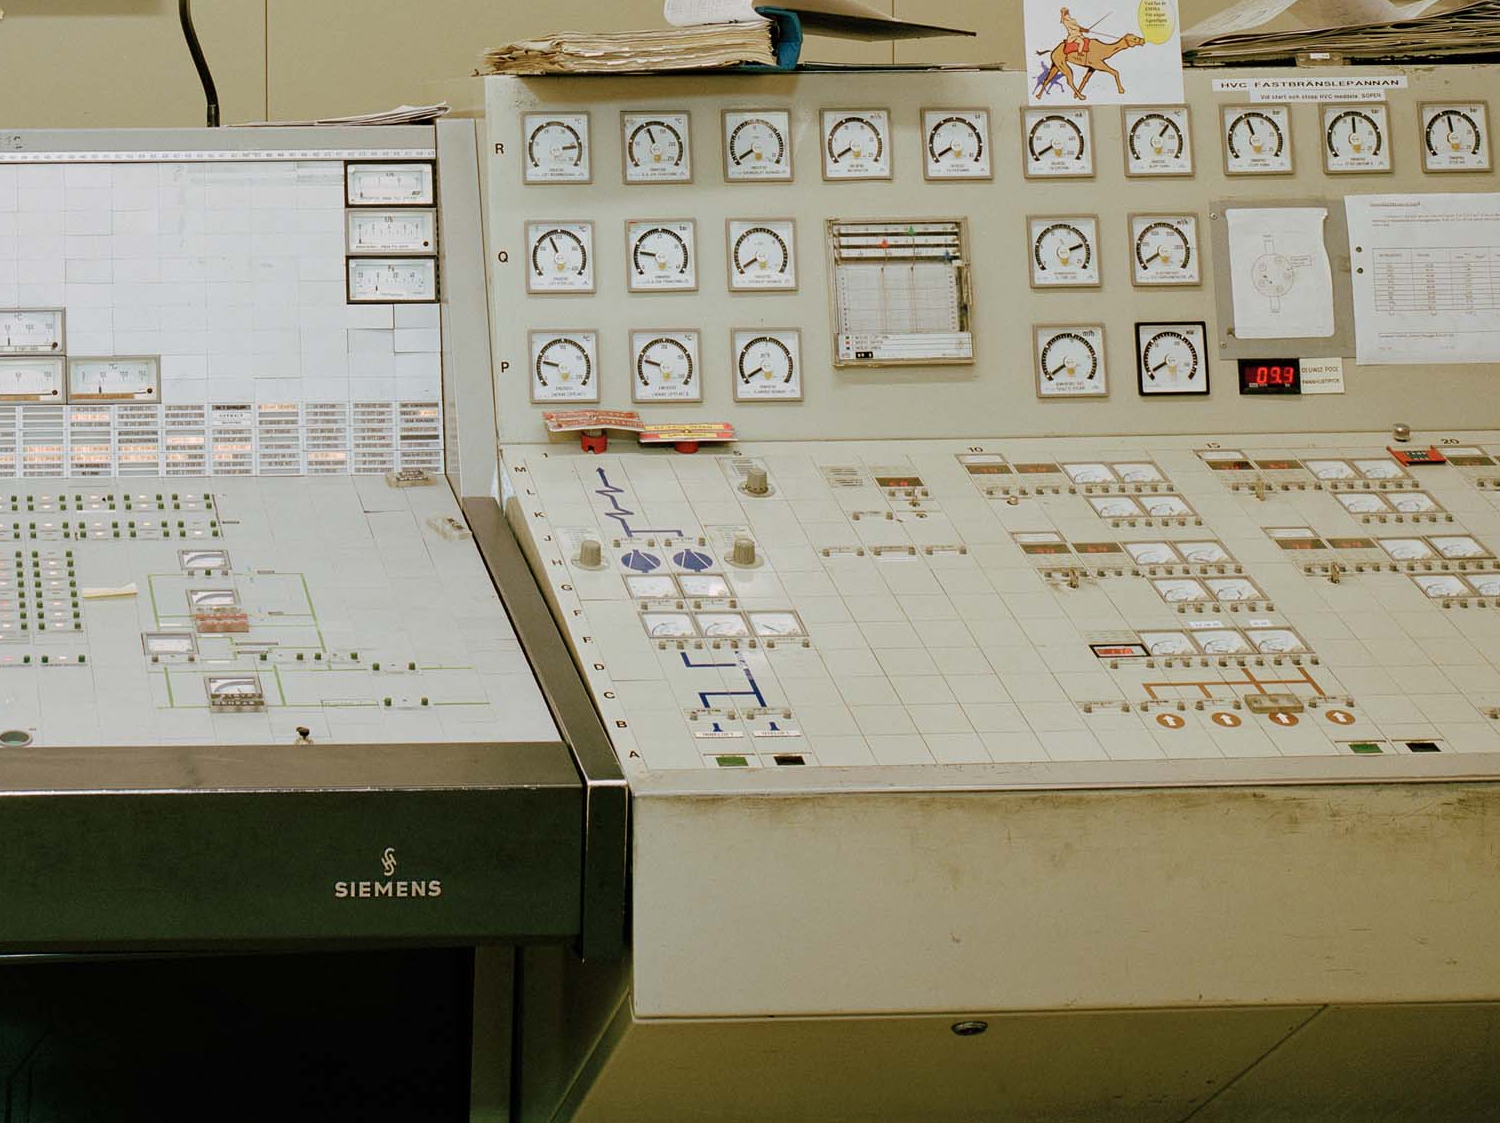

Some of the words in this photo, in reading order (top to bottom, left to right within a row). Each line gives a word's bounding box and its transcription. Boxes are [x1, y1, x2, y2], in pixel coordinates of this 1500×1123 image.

[1254, 80, 1399, 88] FASTBRÄNSLEPANNAN
[495, 144, 504, 154] R
[498, 251, 509, 263] Q
[501, 362, 509, 373] P
[526, 488, 536, 496] L
[573, 609, 582, 617] F
[593, 663, 605, 671] D
[603, 691, 615, 699] C
[615, 720, 628, 728] B
[629, 750, 640, 758] A
[335, 880, 442, 897] SIEMENS
